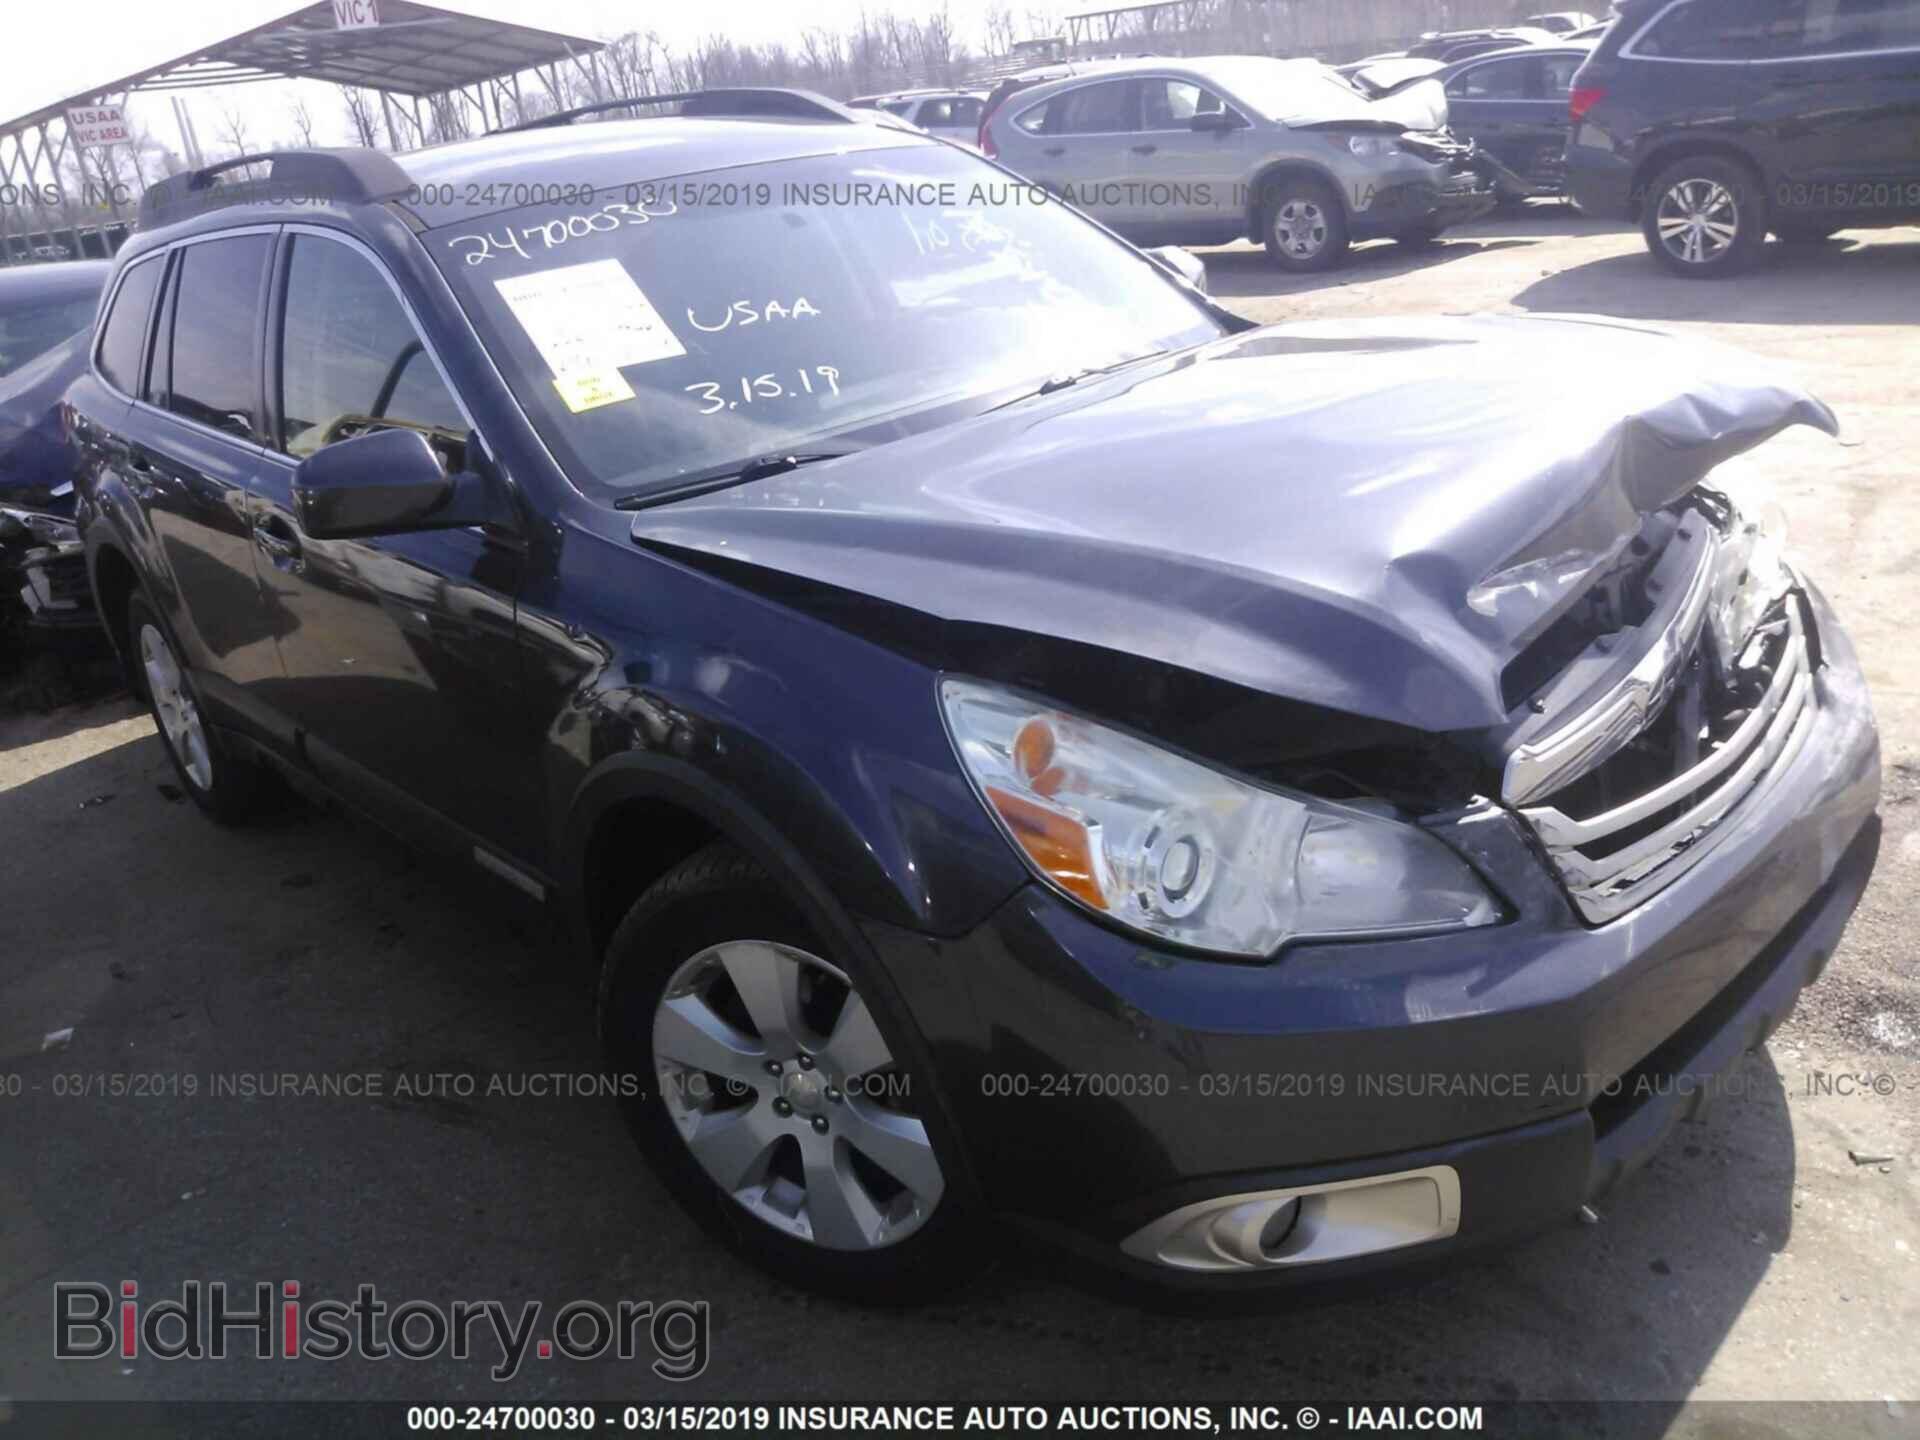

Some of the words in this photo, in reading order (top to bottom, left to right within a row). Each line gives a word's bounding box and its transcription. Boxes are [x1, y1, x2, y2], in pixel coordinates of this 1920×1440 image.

[335, 0, 365, 25] VIC
[71, 110, 121, 125] USAA
[448, 199, 678, 266] 24700030
[687, 297, 822, 332] USAA
[683, 365, 840, 415] 3.15.19
